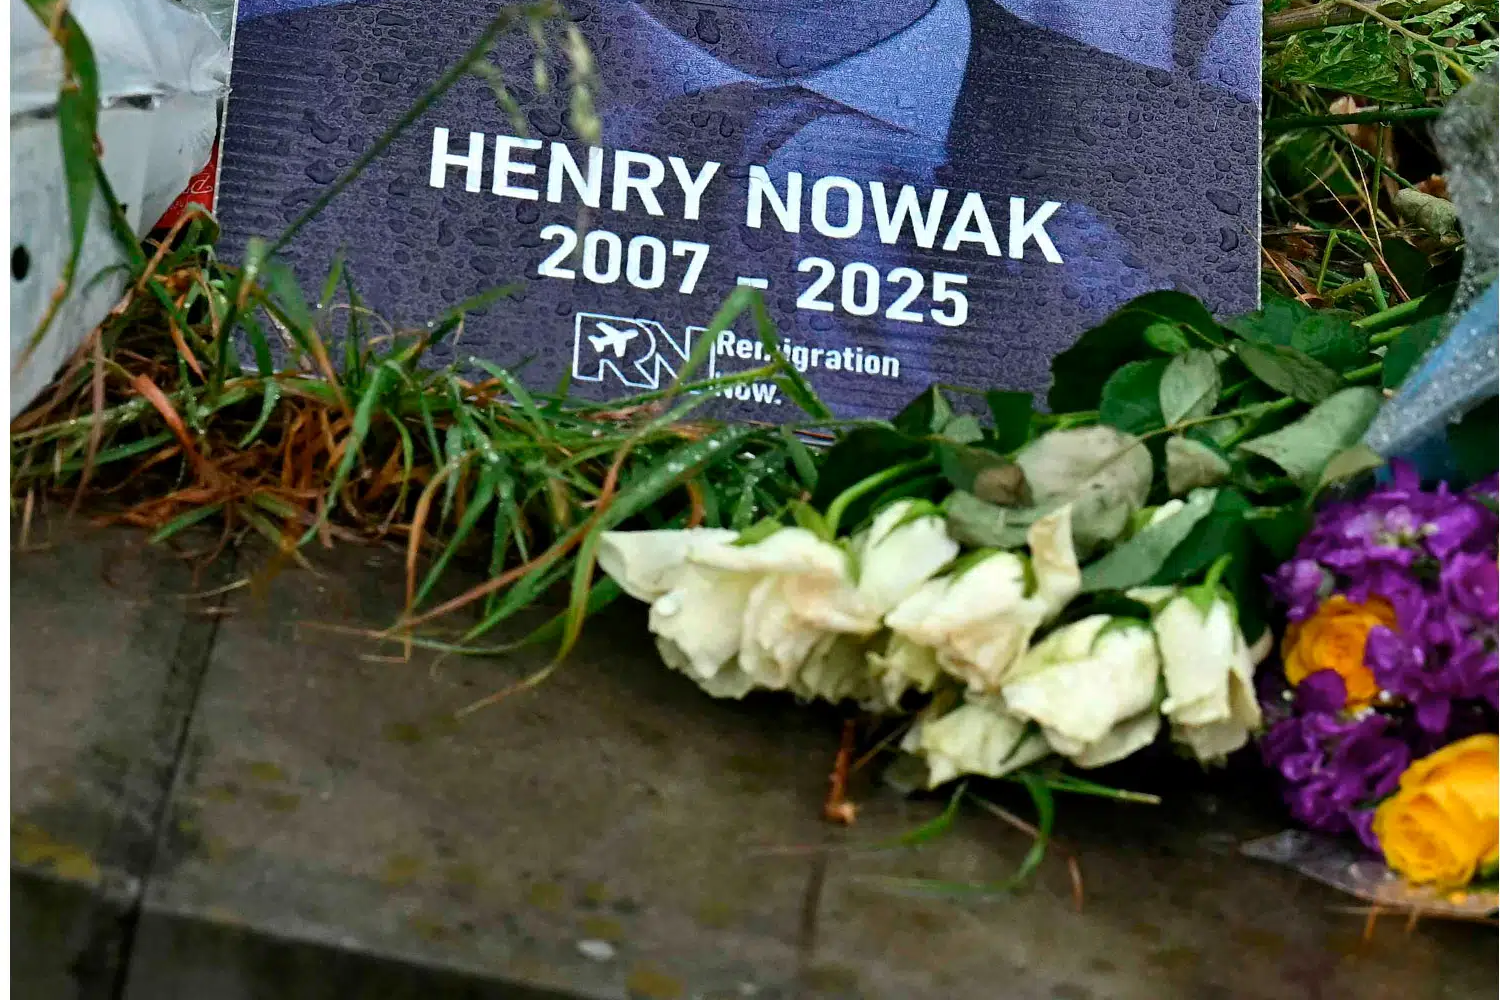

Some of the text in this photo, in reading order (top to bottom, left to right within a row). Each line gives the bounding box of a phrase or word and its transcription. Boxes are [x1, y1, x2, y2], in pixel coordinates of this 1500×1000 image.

[429, 127, 1065, 265] HENRY NOWAK
[538, 224, 711, 294] 2007
[796, 256, 969, 328] 2025
